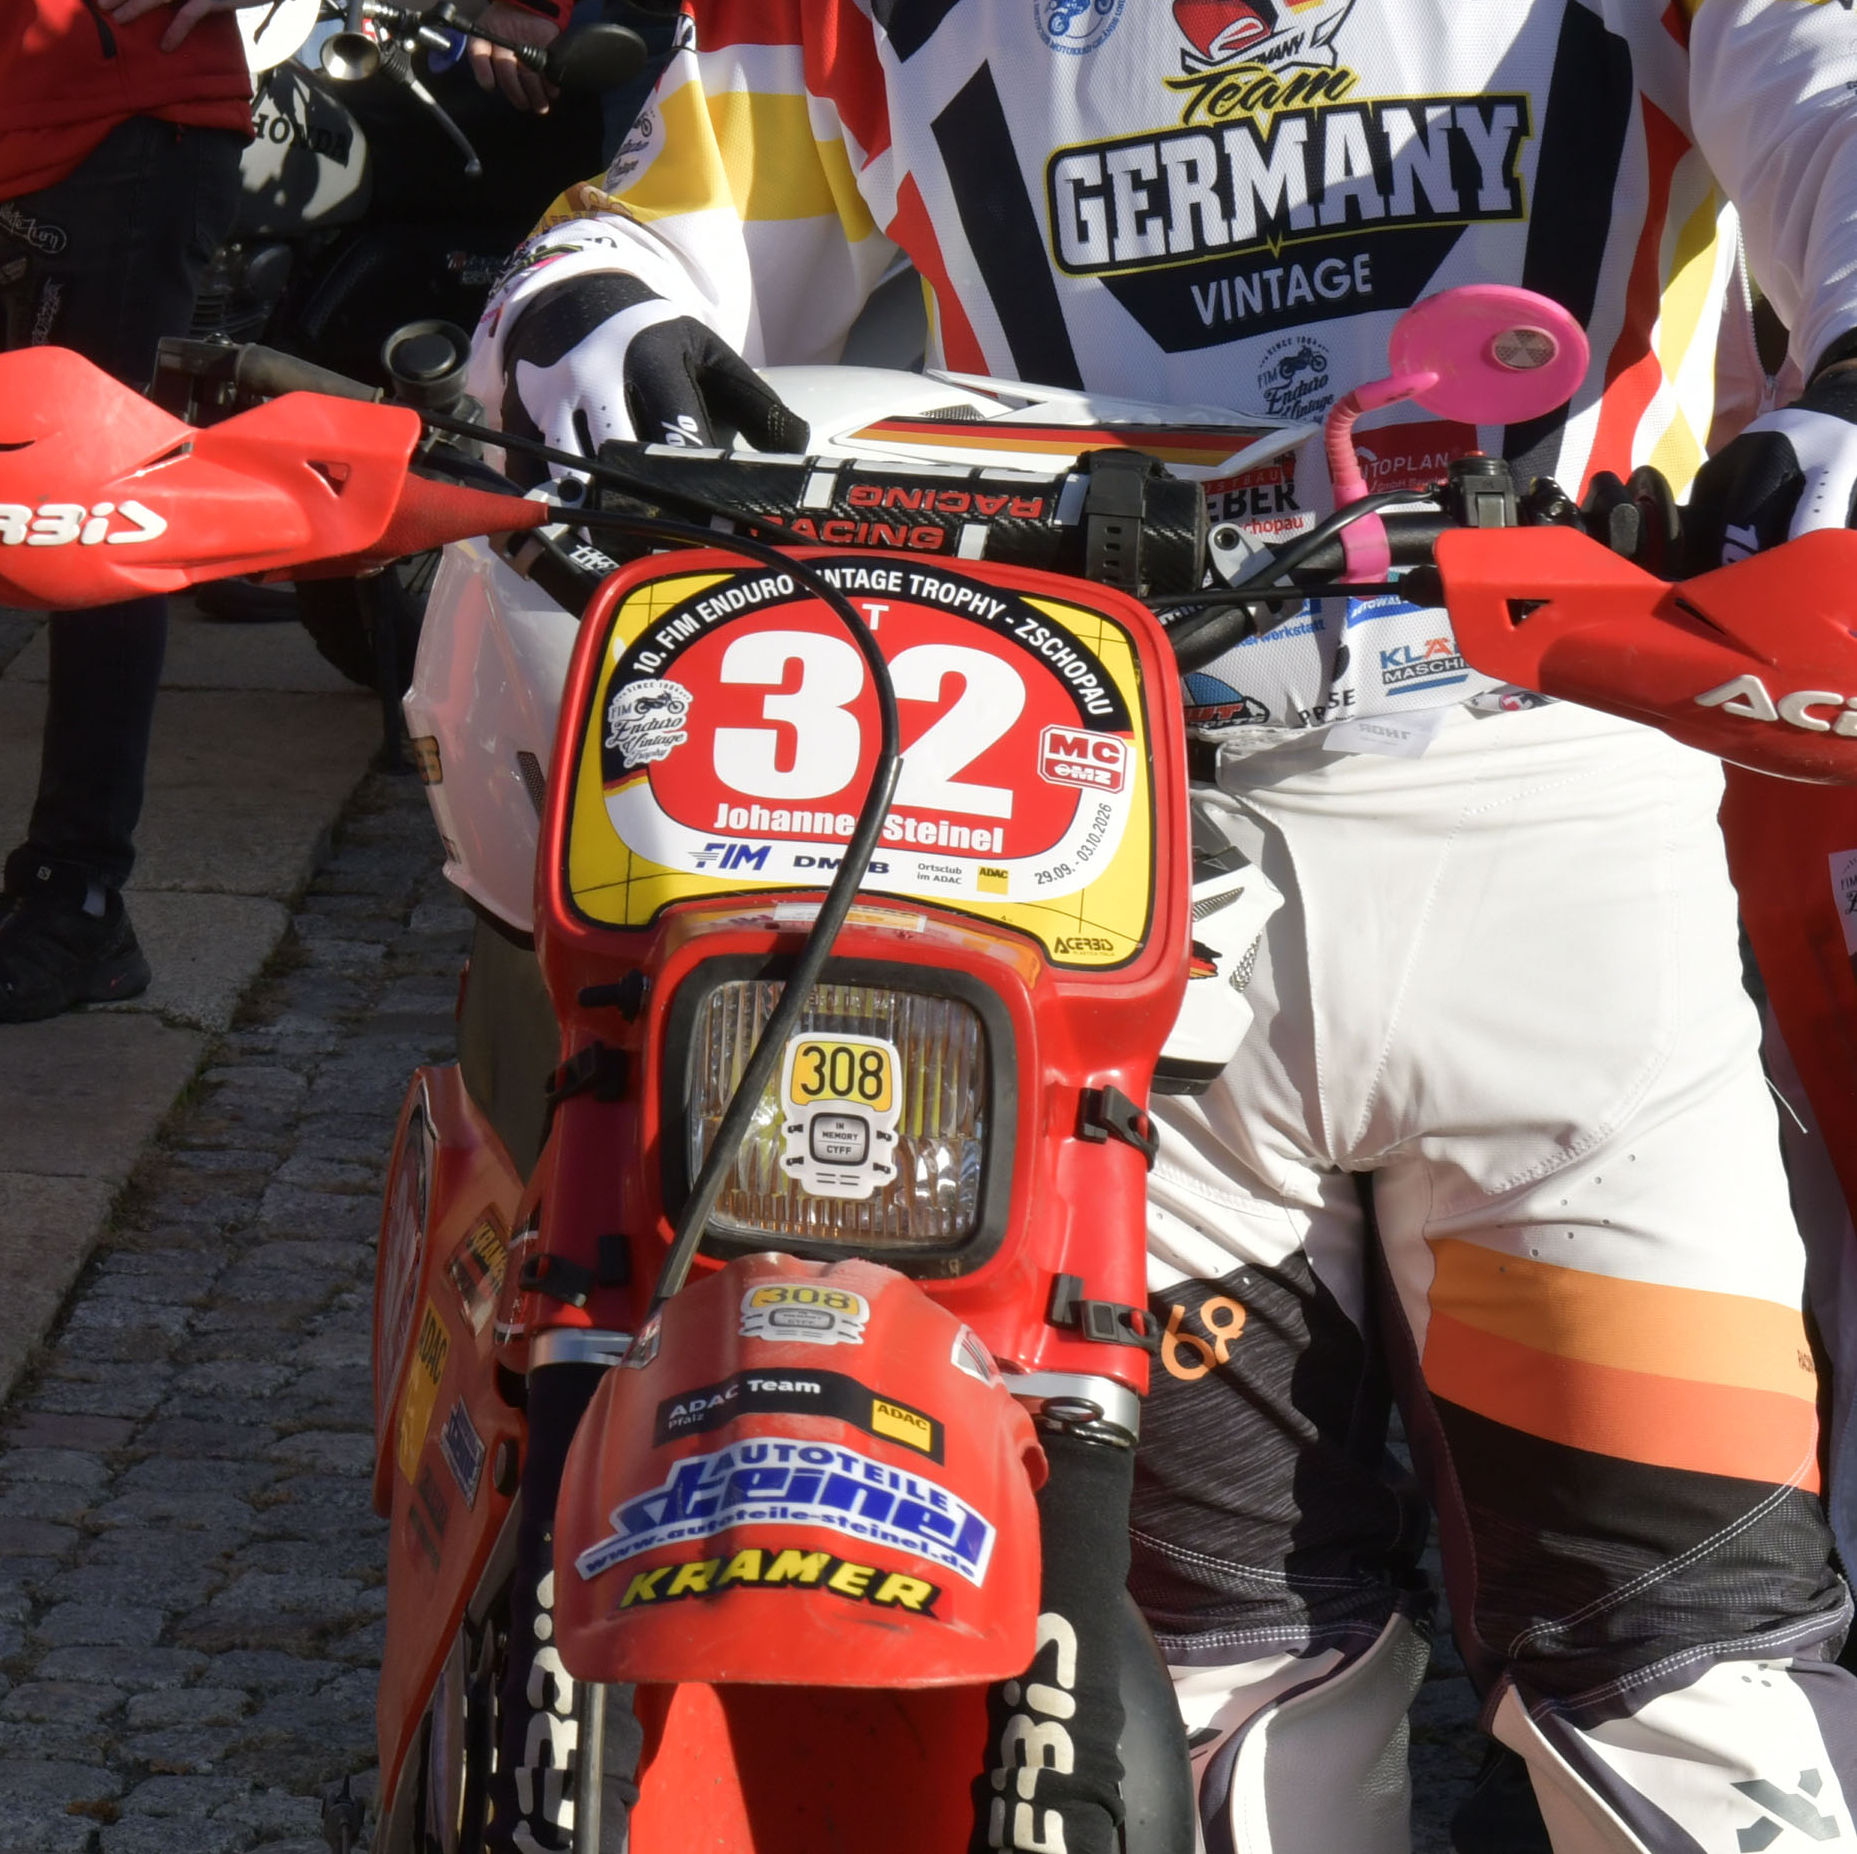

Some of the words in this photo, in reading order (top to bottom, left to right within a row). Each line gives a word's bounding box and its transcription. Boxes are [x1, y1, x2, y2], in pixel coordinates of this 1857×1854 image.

[1167, 65, 1357, 125] Team
[1057, 103, 1523, 269] GERMANY
[1190, 252, 1374, 329] VINTAGE
[848, 483, 1046, 519] RACING
[862, 602, 890, 631] T
[656, 613, 699, 650] FIM
[701, 573, 796, 622] ENDURO
[909, 572, 1006, 621] TROPHY
[1012, 615, 1115, 718] ZSCHOPAU
[608, 714, 683, 744] Enduro
[713, 629, 1027, 819] 32
[622, 732, 685, 754] Vintage
[1048, 731, 1120, 765] MC
[714, 802, 857, 836] Johanne
[884, 820, 1004, 854] Steinel
[1077, 802, 1113, 863] 03.10.2026
[687, 842, 772, 871] FIM
[793, 854, 890, 875] DMB
[917, 861, 963, 878] Ortsclub
[932, 873, 963, 886] ADAC
[978, 865, 1009, 881] ADAC
[800, 1045, 884, 1101] 308
[821, 1130, 859, 1141] MEMORY
[835, 1121, 845, 1130] IN
[826, 1144, 853, 1155] CYFF
[761, 1286, 851, 1309] 308
[667, 1382, 739, 1421] ADAC
[747, 1376, 821, 1398] Team
[666, 1410, 705, 1431] Pfalz
[876, 1402, 929, 1433] ADAC
[713, 1442, 950, 1514] AUTOTEILE
[587, 1503, 976, 1579] www.autoteile-steinel.de
[619, 1547, 941, 1618] KRAMER
